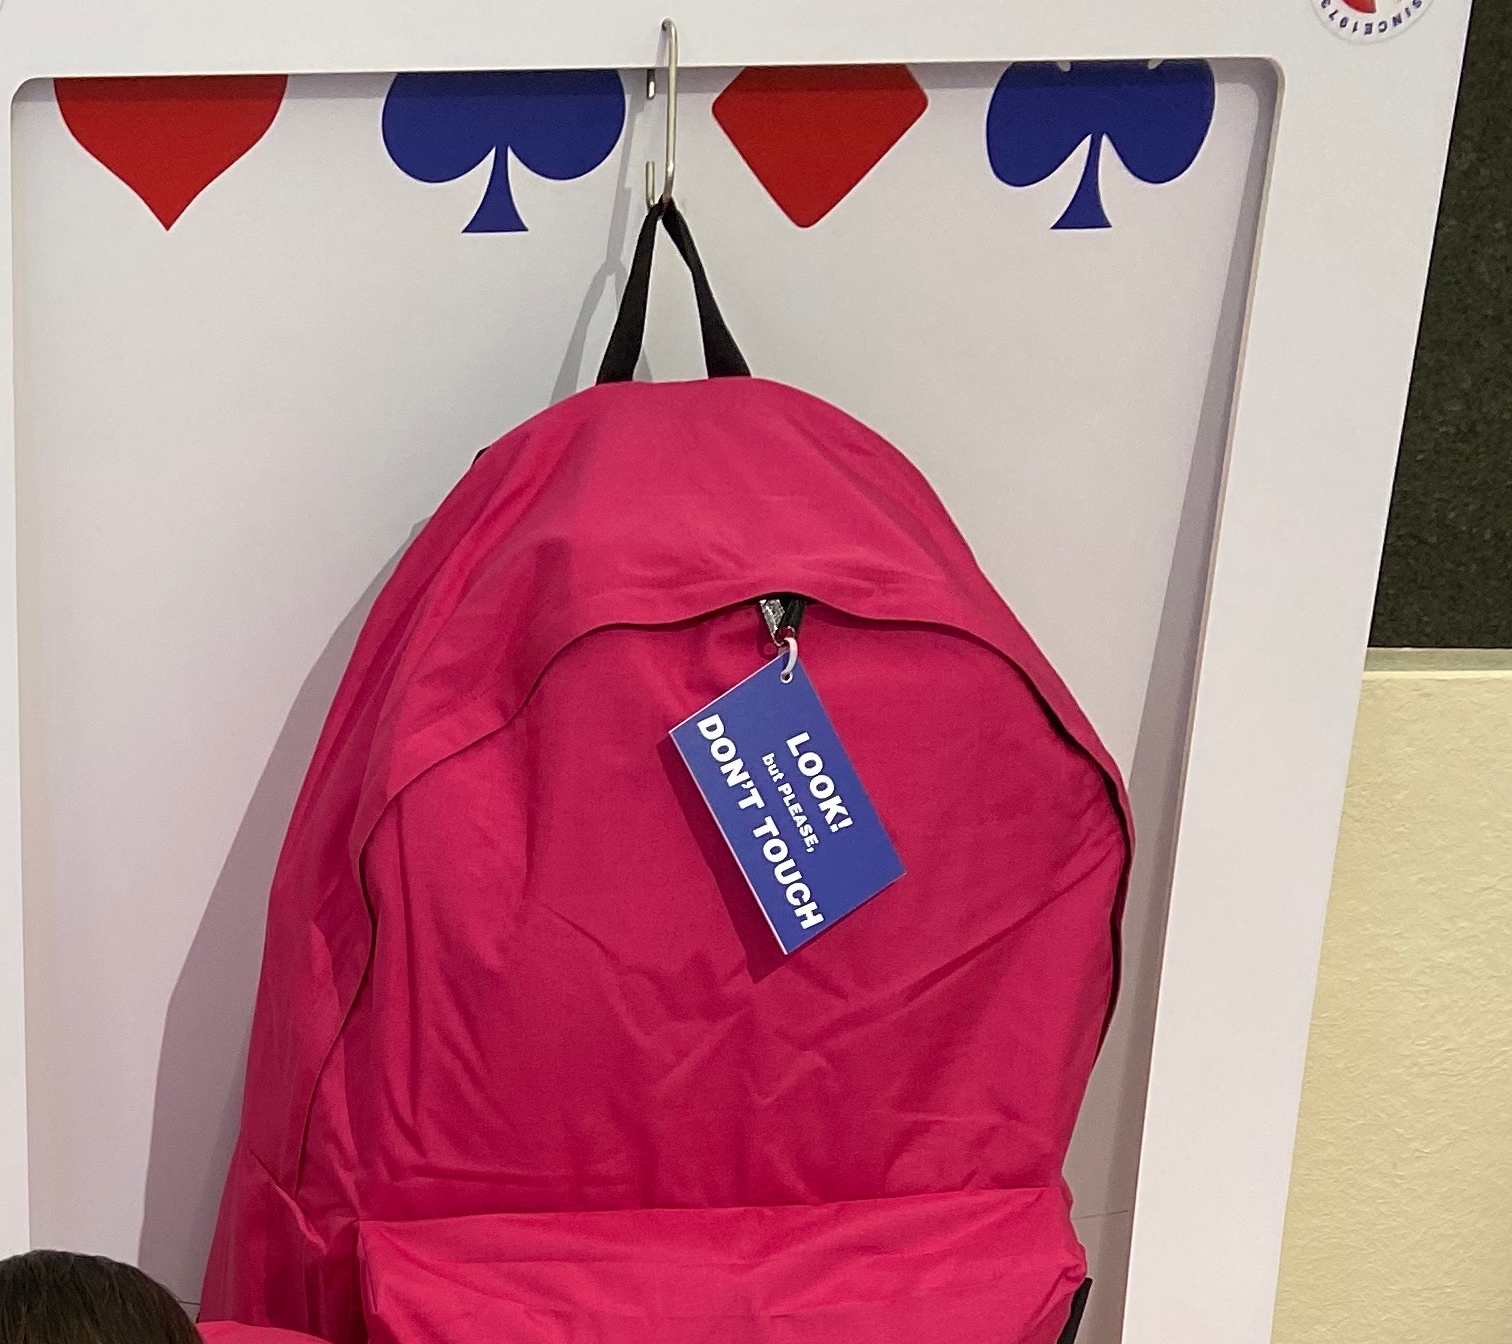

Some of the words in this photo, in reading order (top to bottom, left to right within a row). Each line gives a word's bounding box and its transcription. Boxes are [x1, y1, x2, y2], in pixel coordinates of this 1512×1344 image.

[696, 713, 766, 810] DON'T
[752, 815, 825, 930] TOUCH
[761, 752, 785, 783] but
[777, 782, 819, 854] PLEASE,
[786, 731, 854, 833] LOOK!
